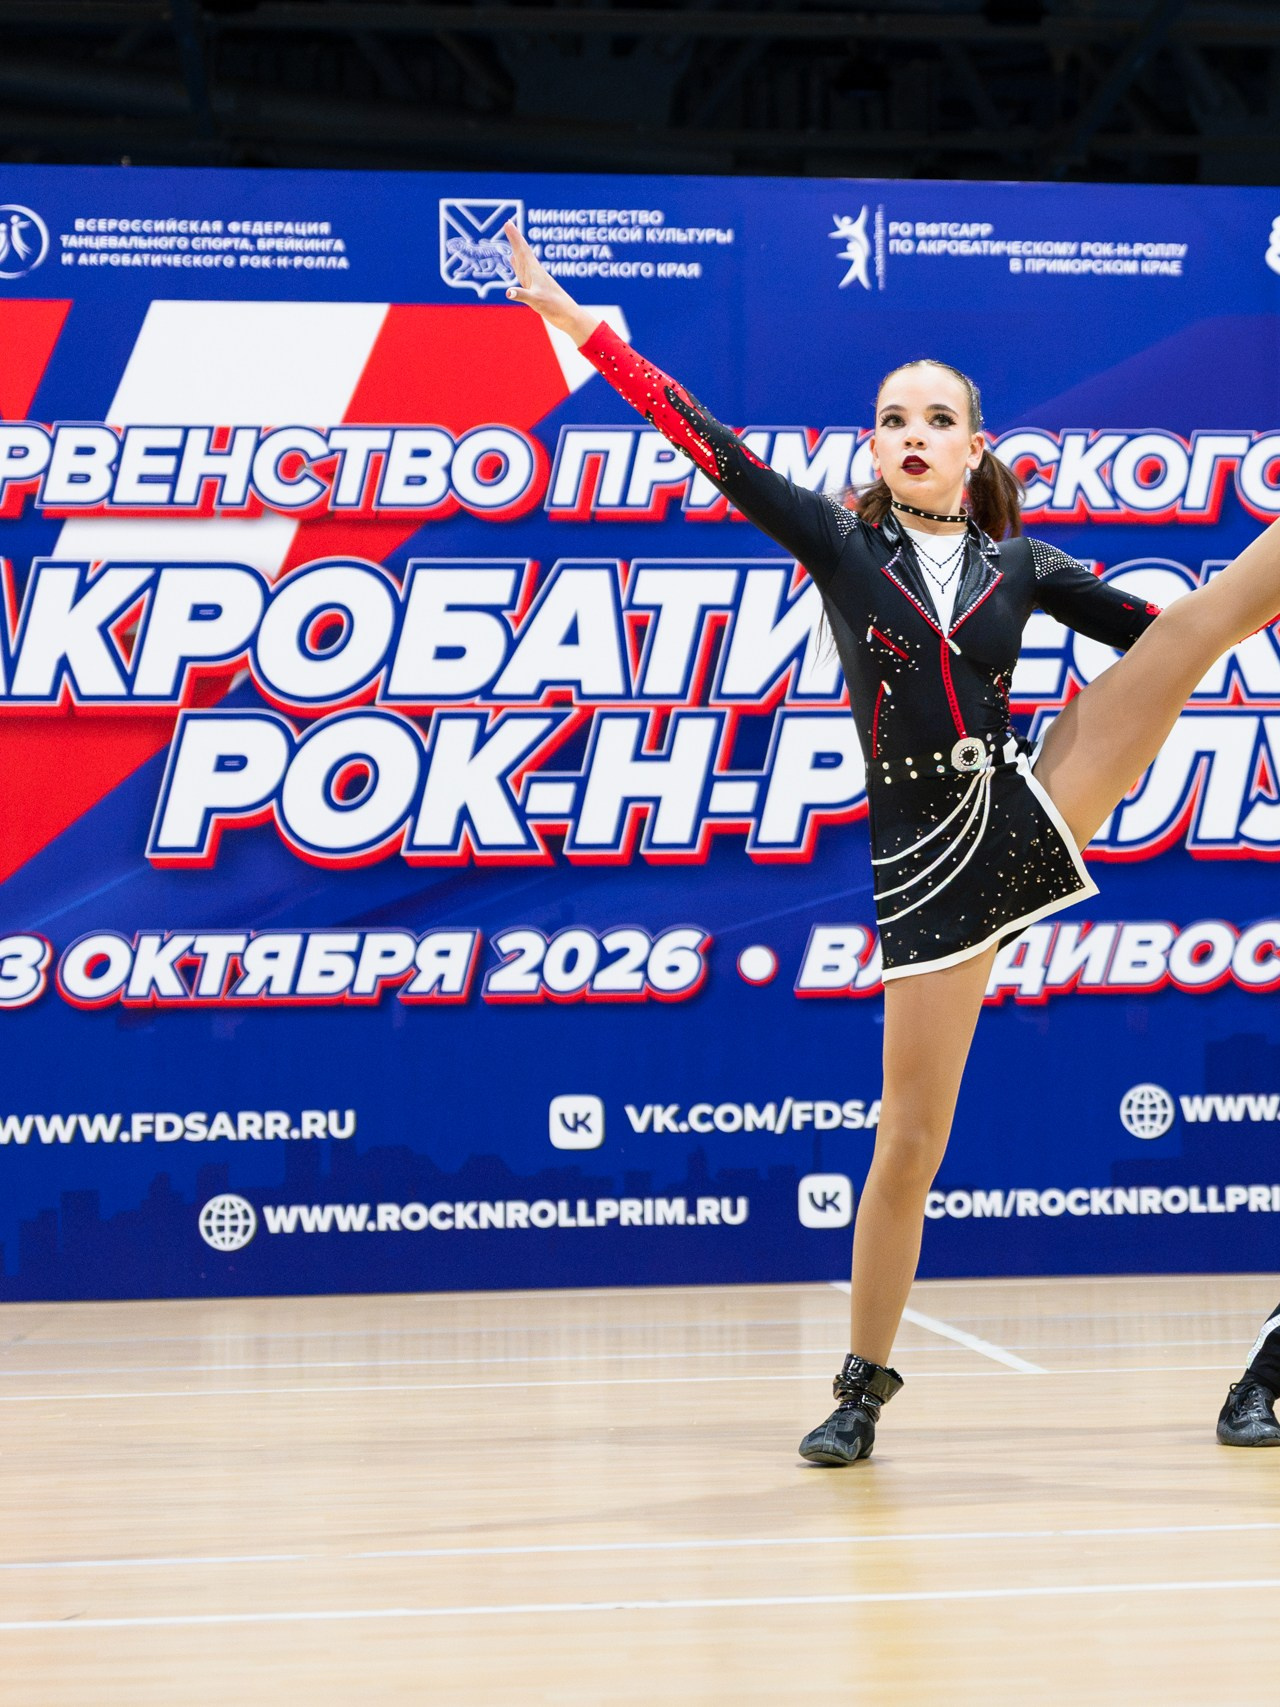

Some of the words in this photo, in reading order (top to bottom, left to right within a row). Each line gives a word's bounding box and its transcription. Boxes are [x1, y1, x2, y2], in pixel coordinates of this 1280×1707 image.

[528, 209, 664, 225] МИНИСТЕРСТВО
[75, 218, 223, 234] ВСЕРОССИЙСКАЯ
[227, 220, 331, 236] ФЕДЕРАЦИЯ
[528, 225, 643, 242] ФИЗИЧЕСКОЙ
[645, 227, 733, 244] КУЛЬТУРЫ
[889, 221, 914, 238] РО
[61, 235, 190, 250] ТАНЦЕВАЛЬНОГО
[191, 236, 255, 251] СПОРТА,
[257, 236, 345, 252] БРЕЙКИНГА
[544, 243, 612, 260] СПОРТА
[889, 239, 915, 255] ПО
[916, 239, 1079, 258] АКРОБАТИЧЕСКОМУ
[1080, 241, 1188, 260] РОК-Н-РОЛЛУ
[61, 252, 74, 265] И
[78, 253, 235, 269] АКРОБАТИЧЕСКОГО
[1009, 257, 1023, 275] В
[1025, 258, 1139, 276] ПРИМОРСКОМ
[1140, 260, 1184, 277] КРАЕ
[541, 261, 655, 278] РИМОРСКОГО
[656, 262, 701, 279] КРАЯ
[59, 929, 476, 1002] ОКТЯБРЯ
[483, 928, 706, 996] 2026
[0, 1109, 356, 1145] WWW.FDSARR.RU
[262, 1196, 750, 1234] WWW.ROCKNROLLPRIM.RU
